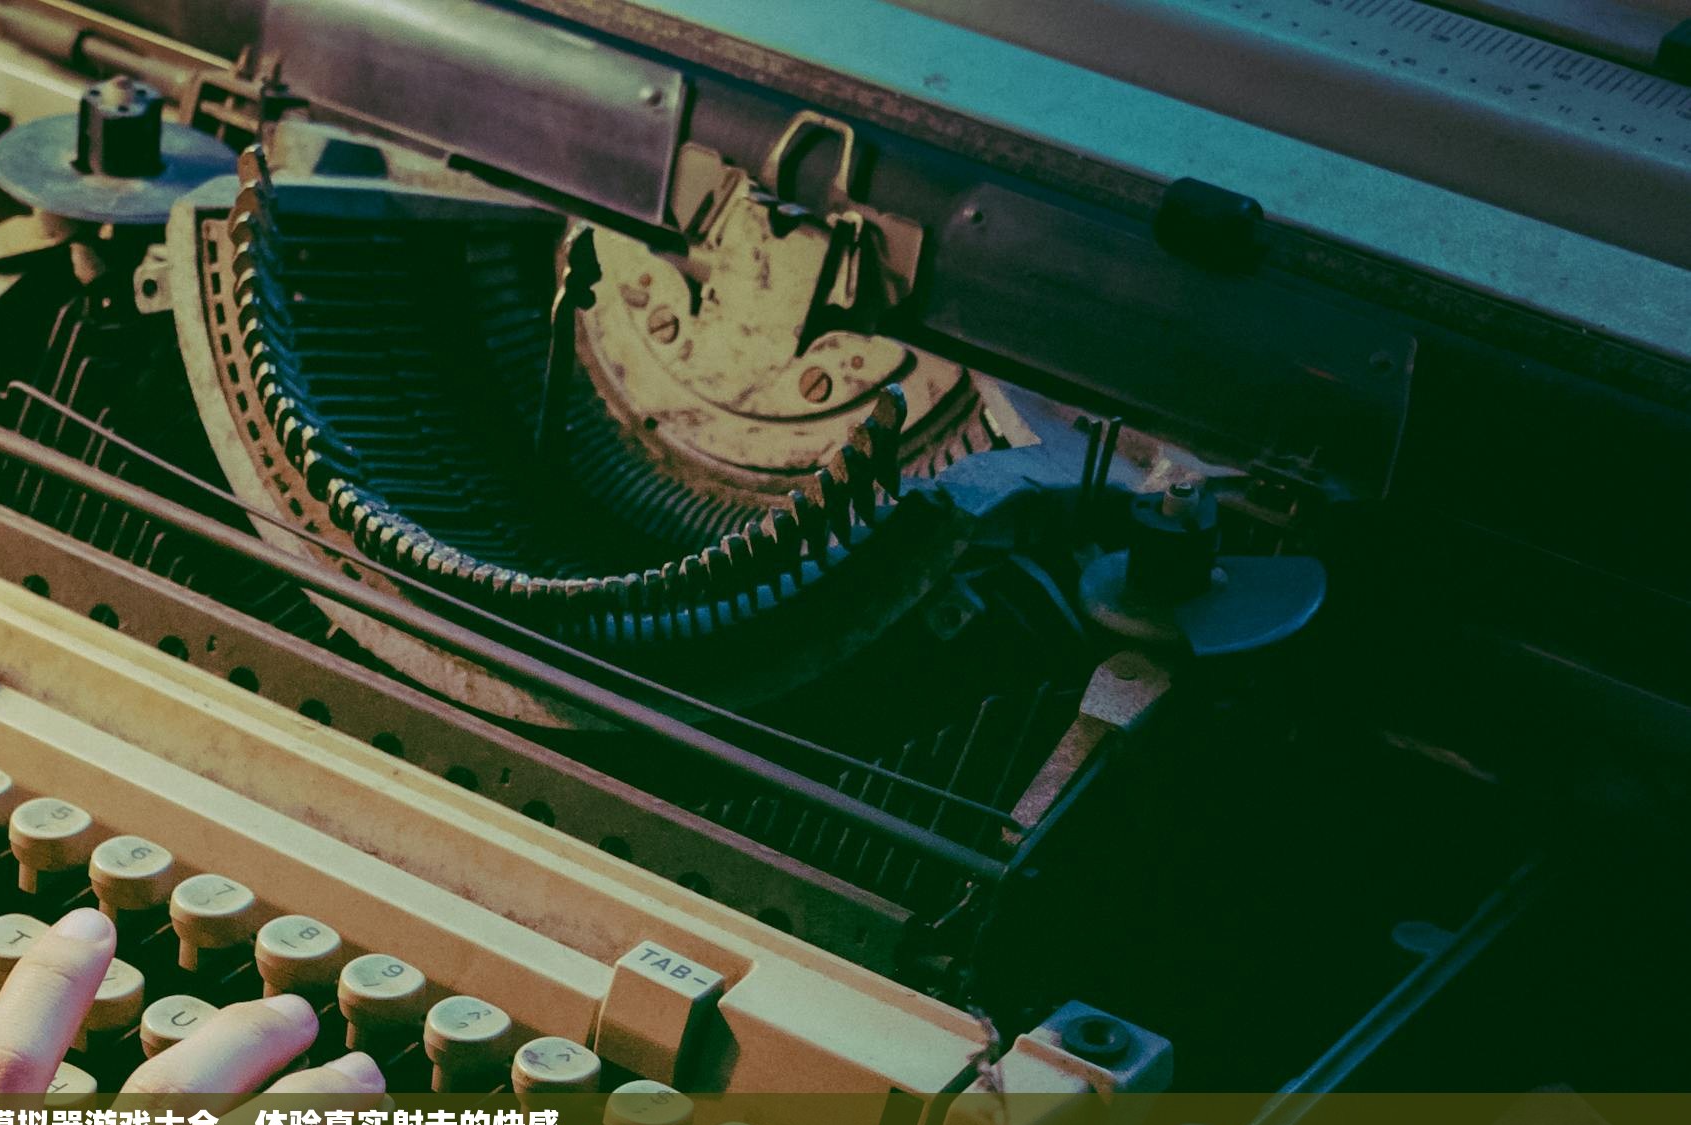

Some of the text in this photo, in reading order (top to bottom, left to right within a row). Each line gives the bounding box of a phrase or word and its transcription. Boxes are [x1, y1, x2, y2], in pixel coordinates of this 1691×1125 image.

[52, 806, 72, 820] 5
[131, 847, 152, 859] 6
[216, 883, 236, 896] 7
[9, 929, 32, 944] T
[300, 927, 320, 940] 8
[382, 964, 404, 978] 9
[171, 1011, 198, 1026] U
